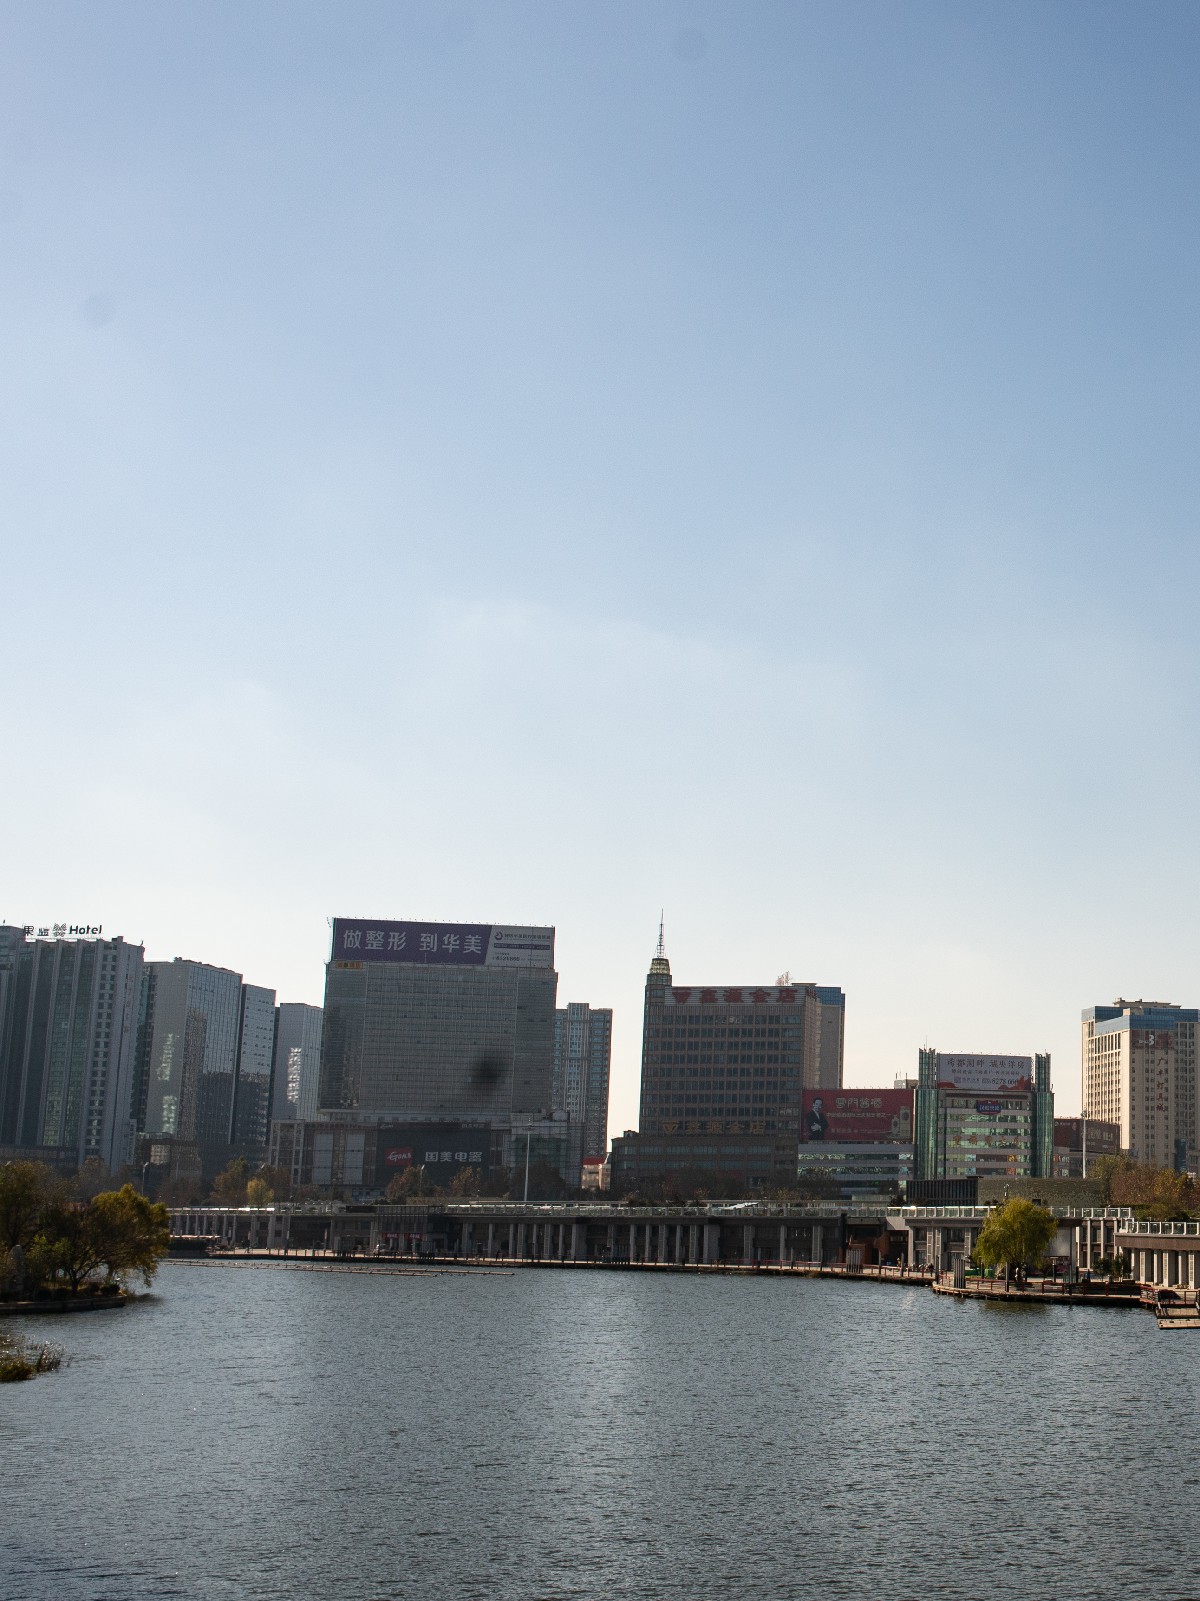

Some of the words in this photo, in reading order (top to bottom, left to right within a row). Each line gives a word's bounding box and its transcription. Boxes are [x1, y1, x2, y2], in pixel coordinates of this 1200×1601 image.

[69, 924, 103, 935] Hotel
[343, 929, 407, 951] 做整形
[419, 932, 482, 954] 到华美
[425, 1151, 483, 1163] 国美电器
